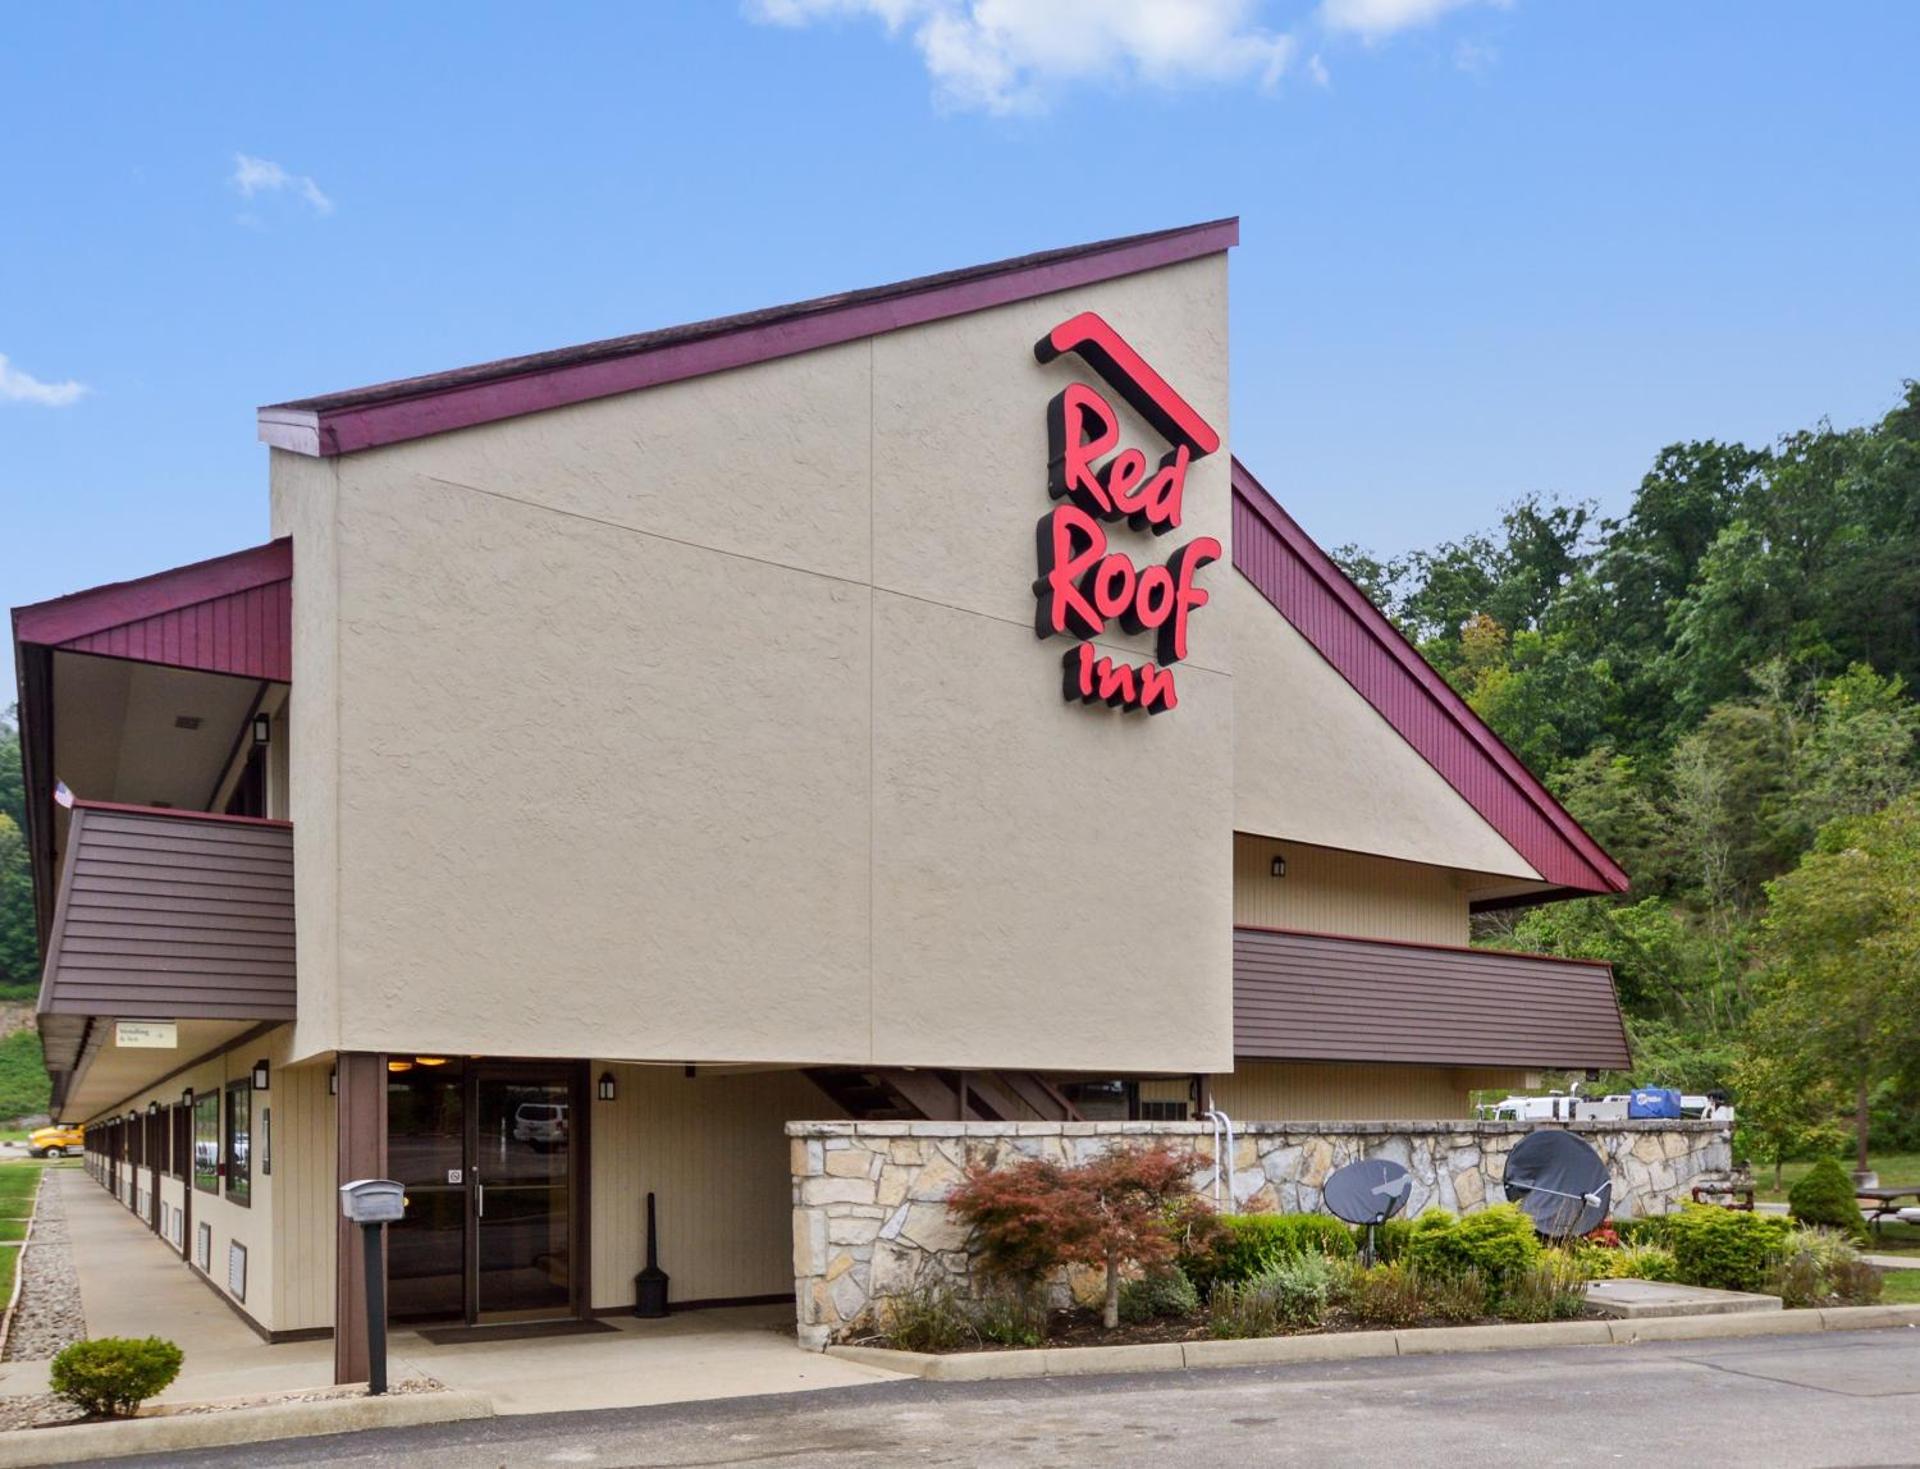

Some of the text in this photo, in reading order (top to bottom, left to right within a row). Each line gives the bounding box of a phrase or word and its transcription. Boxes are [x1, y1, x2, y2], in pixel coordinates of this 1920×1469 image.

[1063, 382, 1190, 528] Red
[1048, 503, 1222, 661] Roof
[1079, 640, 1178, 710] Inn
